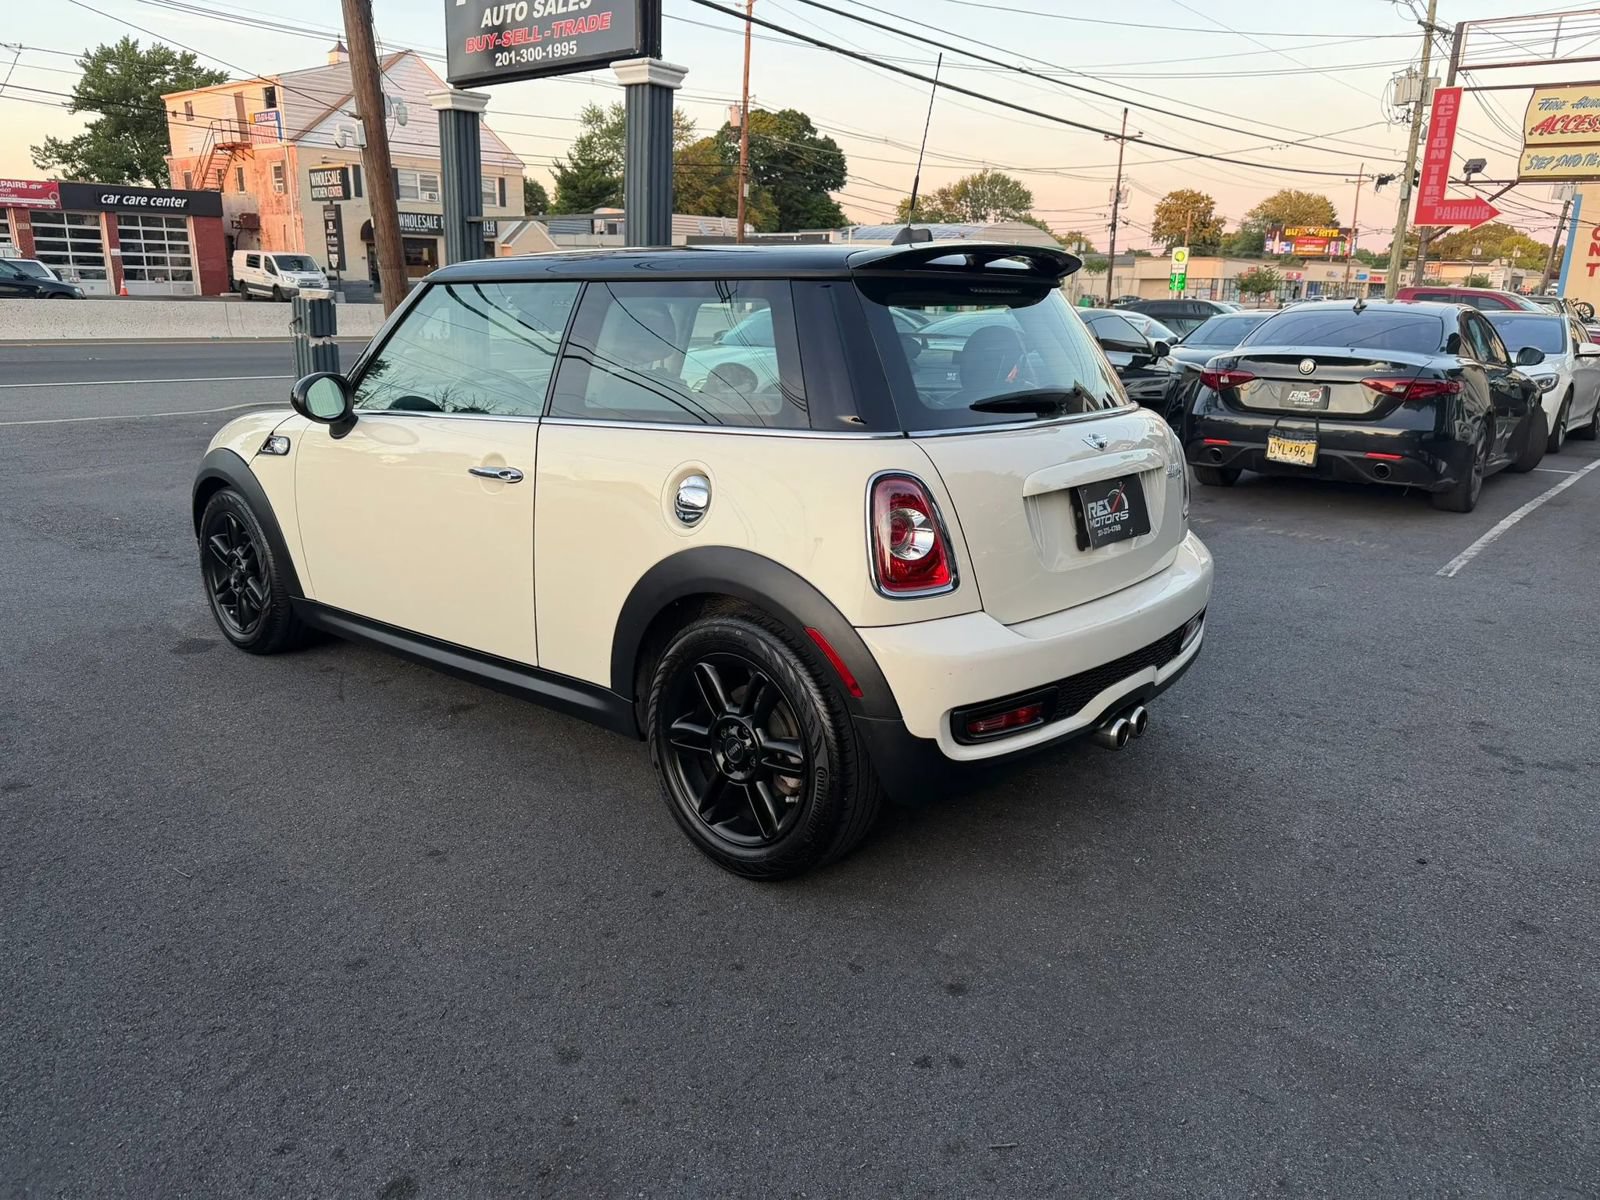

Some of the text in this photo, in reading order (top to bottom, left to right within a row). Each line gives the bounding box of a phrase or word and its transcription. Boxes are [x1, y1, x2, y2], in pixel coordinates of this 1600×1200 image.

[481, 0, 592, 28] AUTO SALES
[495, 40, 577, 67] 201-300-1995
[1430, 94, 1455, 159] ACTION
[0, 180, 28, 189] PAIRS
[310, 170, 342, 186] WHOLESALE
[101, 193, 188, 208] car care center
[398, 213, 439, 229] WHOLESALE
[1434, 206, 1490, 220] PARKING
[1090, 510, 1129, 528] MOTORS
